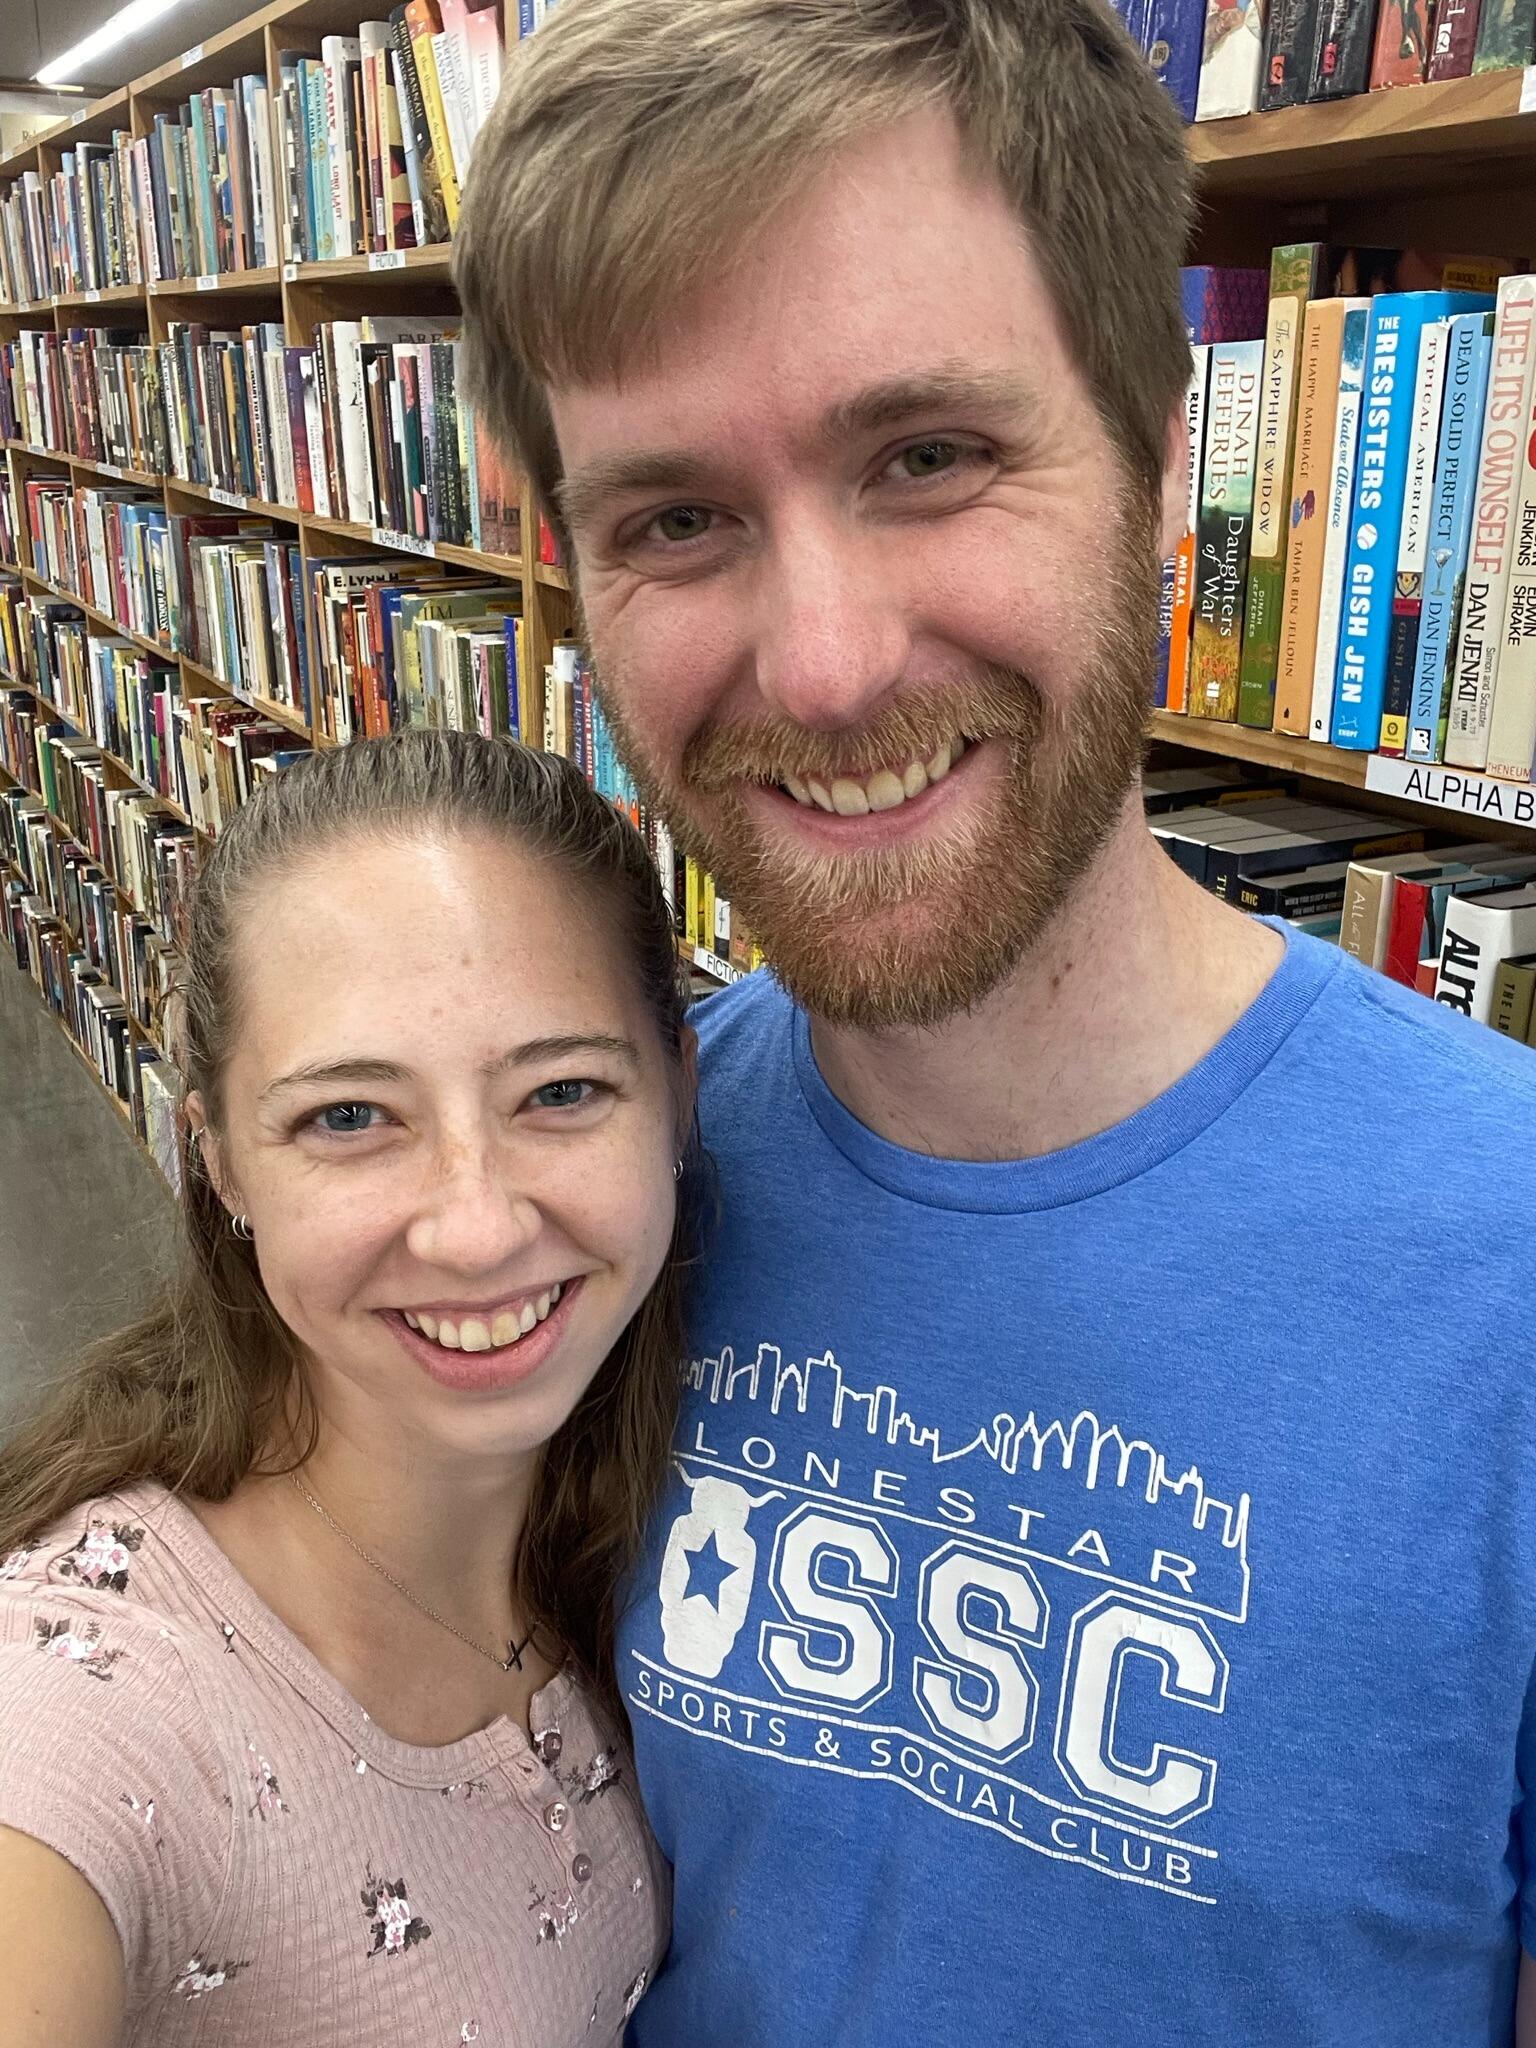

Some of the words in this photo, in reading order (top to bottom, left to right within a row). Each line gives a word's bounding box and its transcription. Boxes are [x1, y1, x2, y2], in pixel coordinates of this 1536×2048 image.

[1275, 319, 1290, 346] The
[1311, 324, 1321, 350] THE
[1378, 316, 1400, 330] THE
[1496, 298, 1535, 368] LIFE
[1306, 357, 1318, 401] HAPPY
[1454, 329, 1474, 386] DEAD
[1264, 350, 1284, 449] SAPPHIRE
[1419, 337, 1438, 432] TYPICAL
[1490, 374, 1525, 422] ITS
[1188, 392, 1199, 436] RULA
[1208, 359, 1236, 500] JEFFERIES
[1232, 374, 1255, 477] DINAH
[1341, 406, 1355, 448] State
[1359, 333, 1399, 510] RESISTERS
[1446, 391, 1467, 452] SOLID
[1300, 407, 1314, 479] MARRIAGE
[1259, 458, 1275, 536] WIDOW
[1332, 463, 1349, 528] Absence
[1407, 442, 1426, 553] AMERICAN
[1437, 457, 1460, 542] PERFECT
[1473, 429, 1518, 575] OWNSELF
[1201, 543, 1221, 566] of
[1516, 500, 1532, 567] JENKINS
[333, 576, 347, 588] E.
[1175, 555, 1188, 607] MIRAL
[1220, 516, 1244, 637] Daughters
[1292, 540, 1303, 584] TAHAR
[1201, 576, 1221, 623] War
[1249, 577, 1259, 638] JEFFERIES
[1256, 590, 1265, 625] DINAH
[1290, 589, 1300, 613] BEN
[1347, 563, 1375, 637] GISH
[1425, 601, 1443, 641] DAN
[1465, 582, 1489, 632] DAN
[1507, 584, 1527, 647] SHRAKE
[1522, 585, 1536, 638] EDWIN
[1285, 618, 1297, 678] JELLOUN
[1395, 622, 1407, 666] GISH
[1457, 633, 1484, 702] JENKI
[1484, 647, 1496, 673] Simon
[1341, 645, 1366, 704] JEN
[1417, 644, 1438, 718] JENKINS
[1481, 674, 1491, 691] and
[1478, 693, 1491, 728] Schuster
[1403, 768, 1503, 817] ALPHA
[1215, 874, 1229, 899] TH
[1241, 890, 1259, 907] ERIC
[1351, 890, 1366, 918] ALL
[1501, 983, 1516, 1009] THE
[757, 1500, 1230, 1829] SSC
[637, 1670, 787, 1748] SPORTS
[814, 1727, 841, 1760] &
[869, 1738, 1025, 1831] SOCIAL
[1050, 1817, 1192, 1886] CLUB
